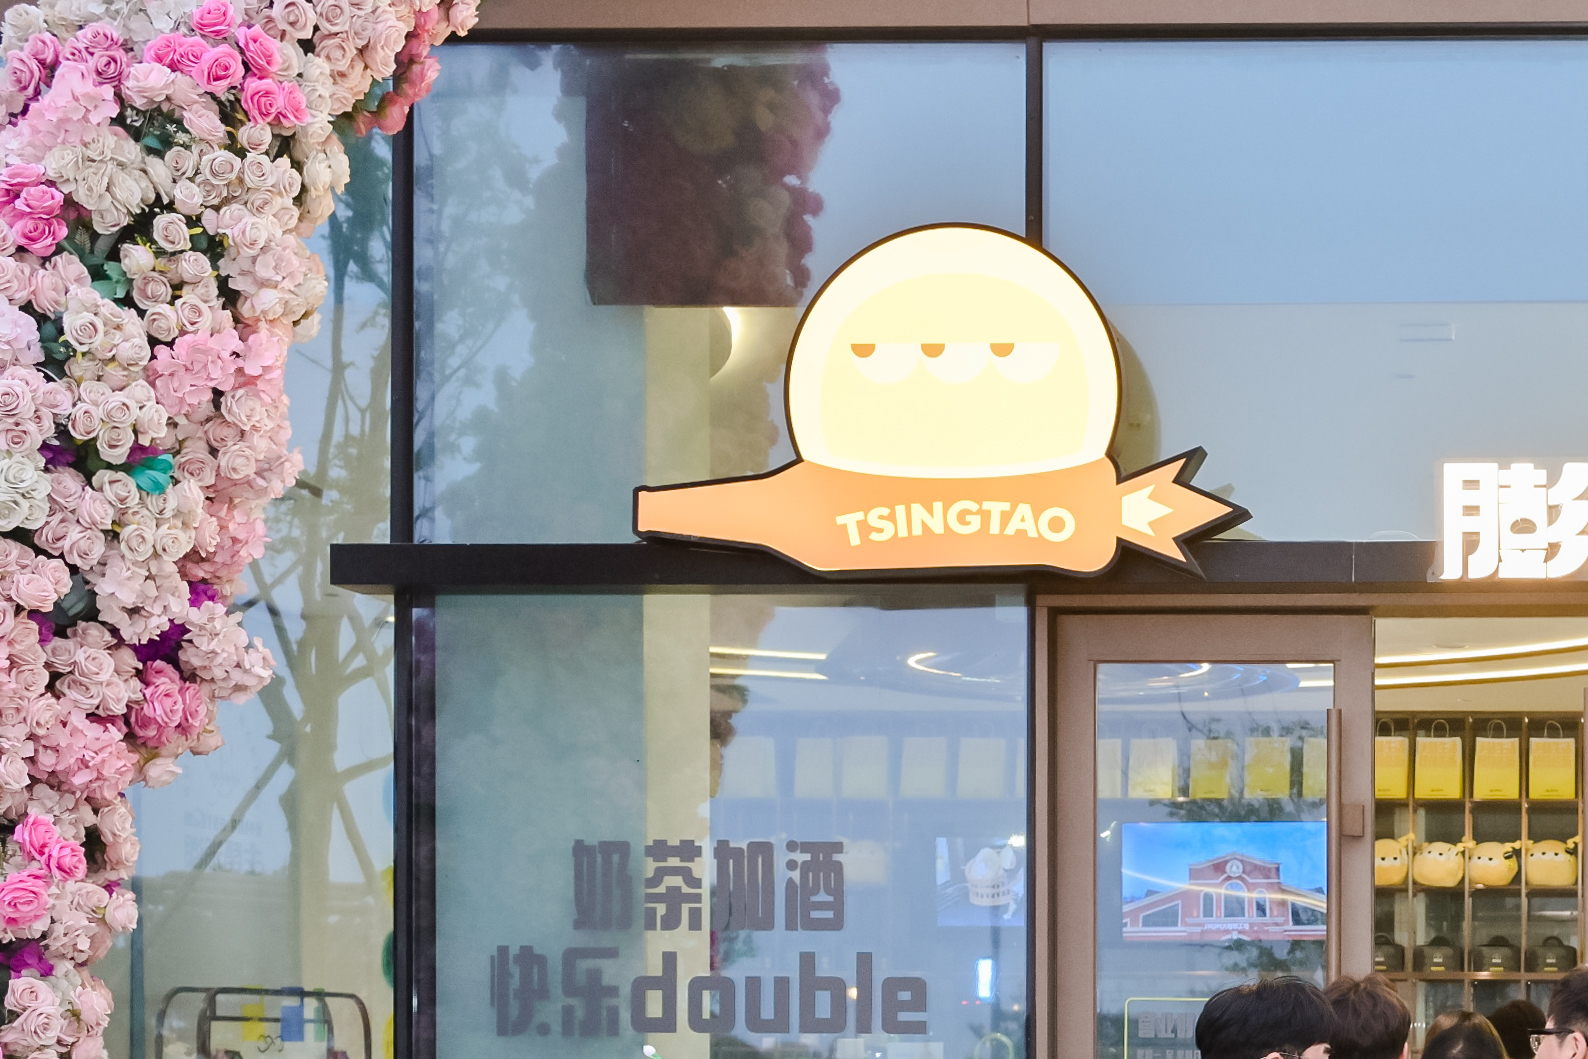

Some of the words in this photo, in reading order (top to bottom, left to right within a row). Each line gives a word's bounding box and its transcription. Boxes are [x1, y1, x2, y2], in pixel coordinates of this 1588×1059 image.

[836, 499, 1075, 546] TSINGTAO
[572, 839, 845, 931] 奶茶加酒
